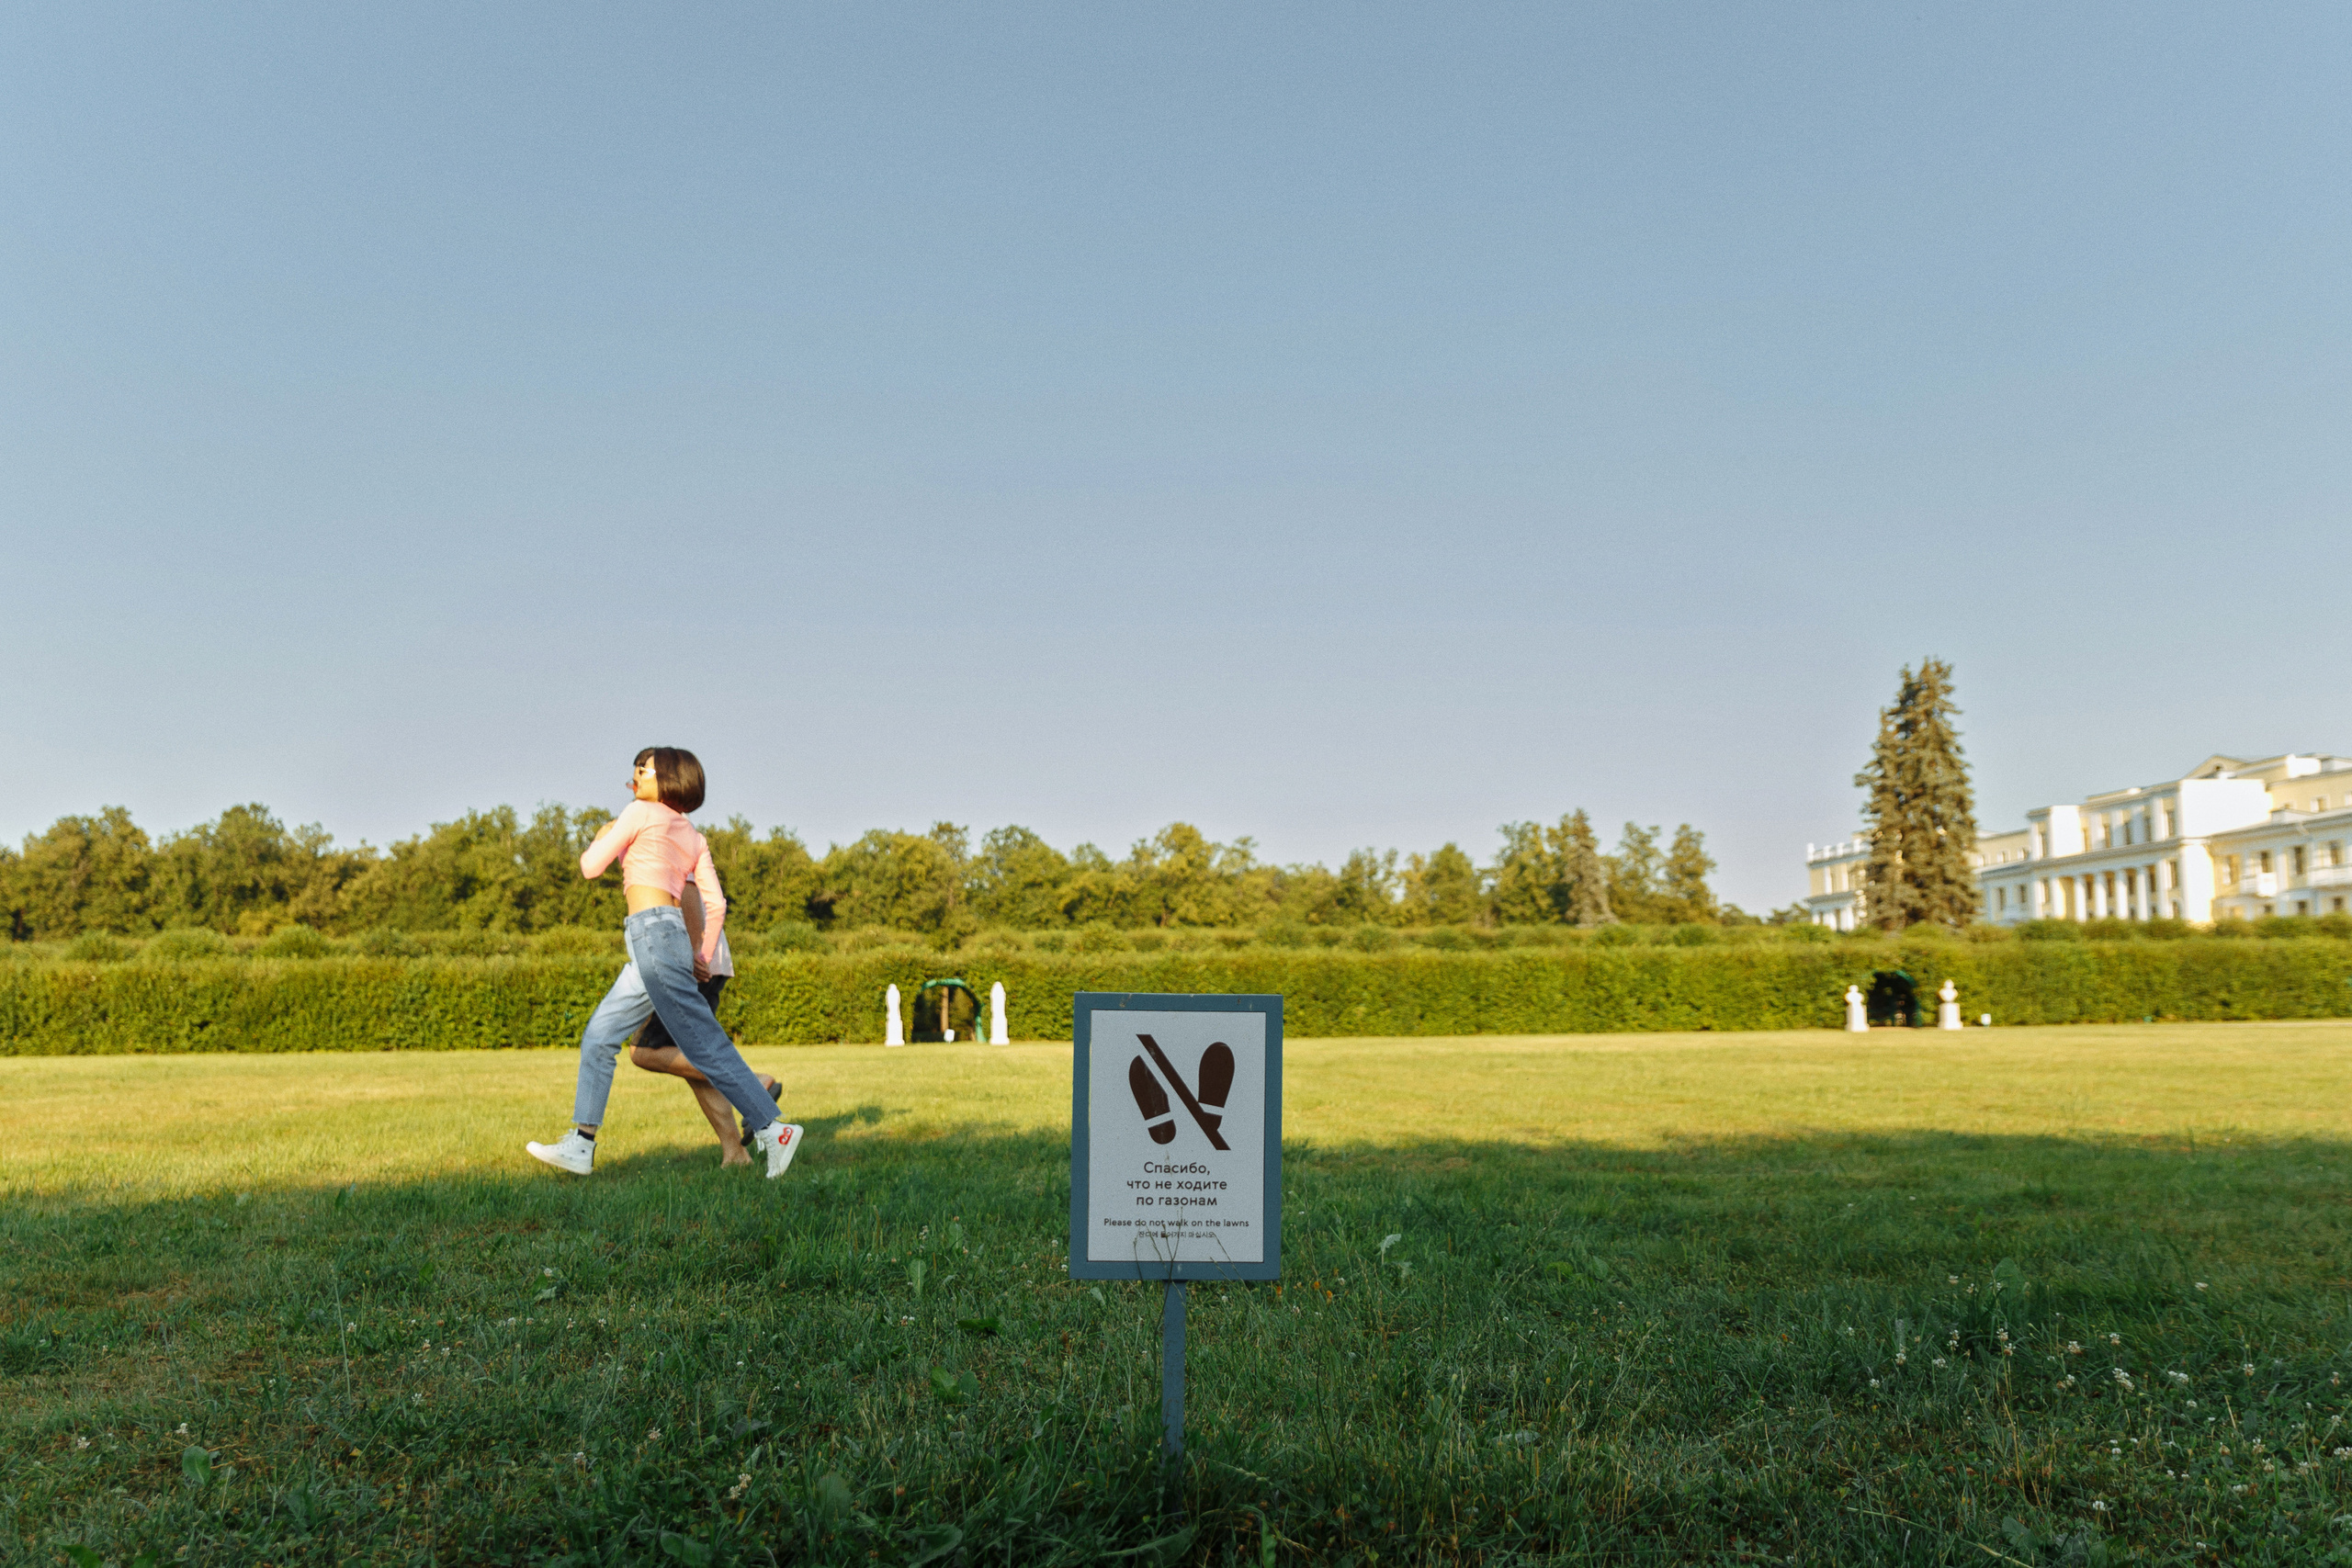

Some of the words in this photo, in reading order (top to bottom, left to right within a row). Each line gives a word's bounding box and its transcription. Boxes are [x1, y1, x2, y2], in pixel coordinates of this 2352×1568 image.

[1144, 1161, 1211, 1176] Спасибо,
[1126, 1180, 1150, 1190] что
[1155, 1180, 1172, 1190] не
[1177, 1180, 1227, 1191] ходите
[1136, 1196, 1154, 1205] по
[1159, 1196, 1217, 1206] газонам
[1103, 1218, 1132, 1226] Please
[1135, 1218, 1147, 1226] do
[1168, 1218, 1188, 1227] walk
[1205, 1219, 1221, 1227] the
[1223, 1219, 1250, 1227] lawns
